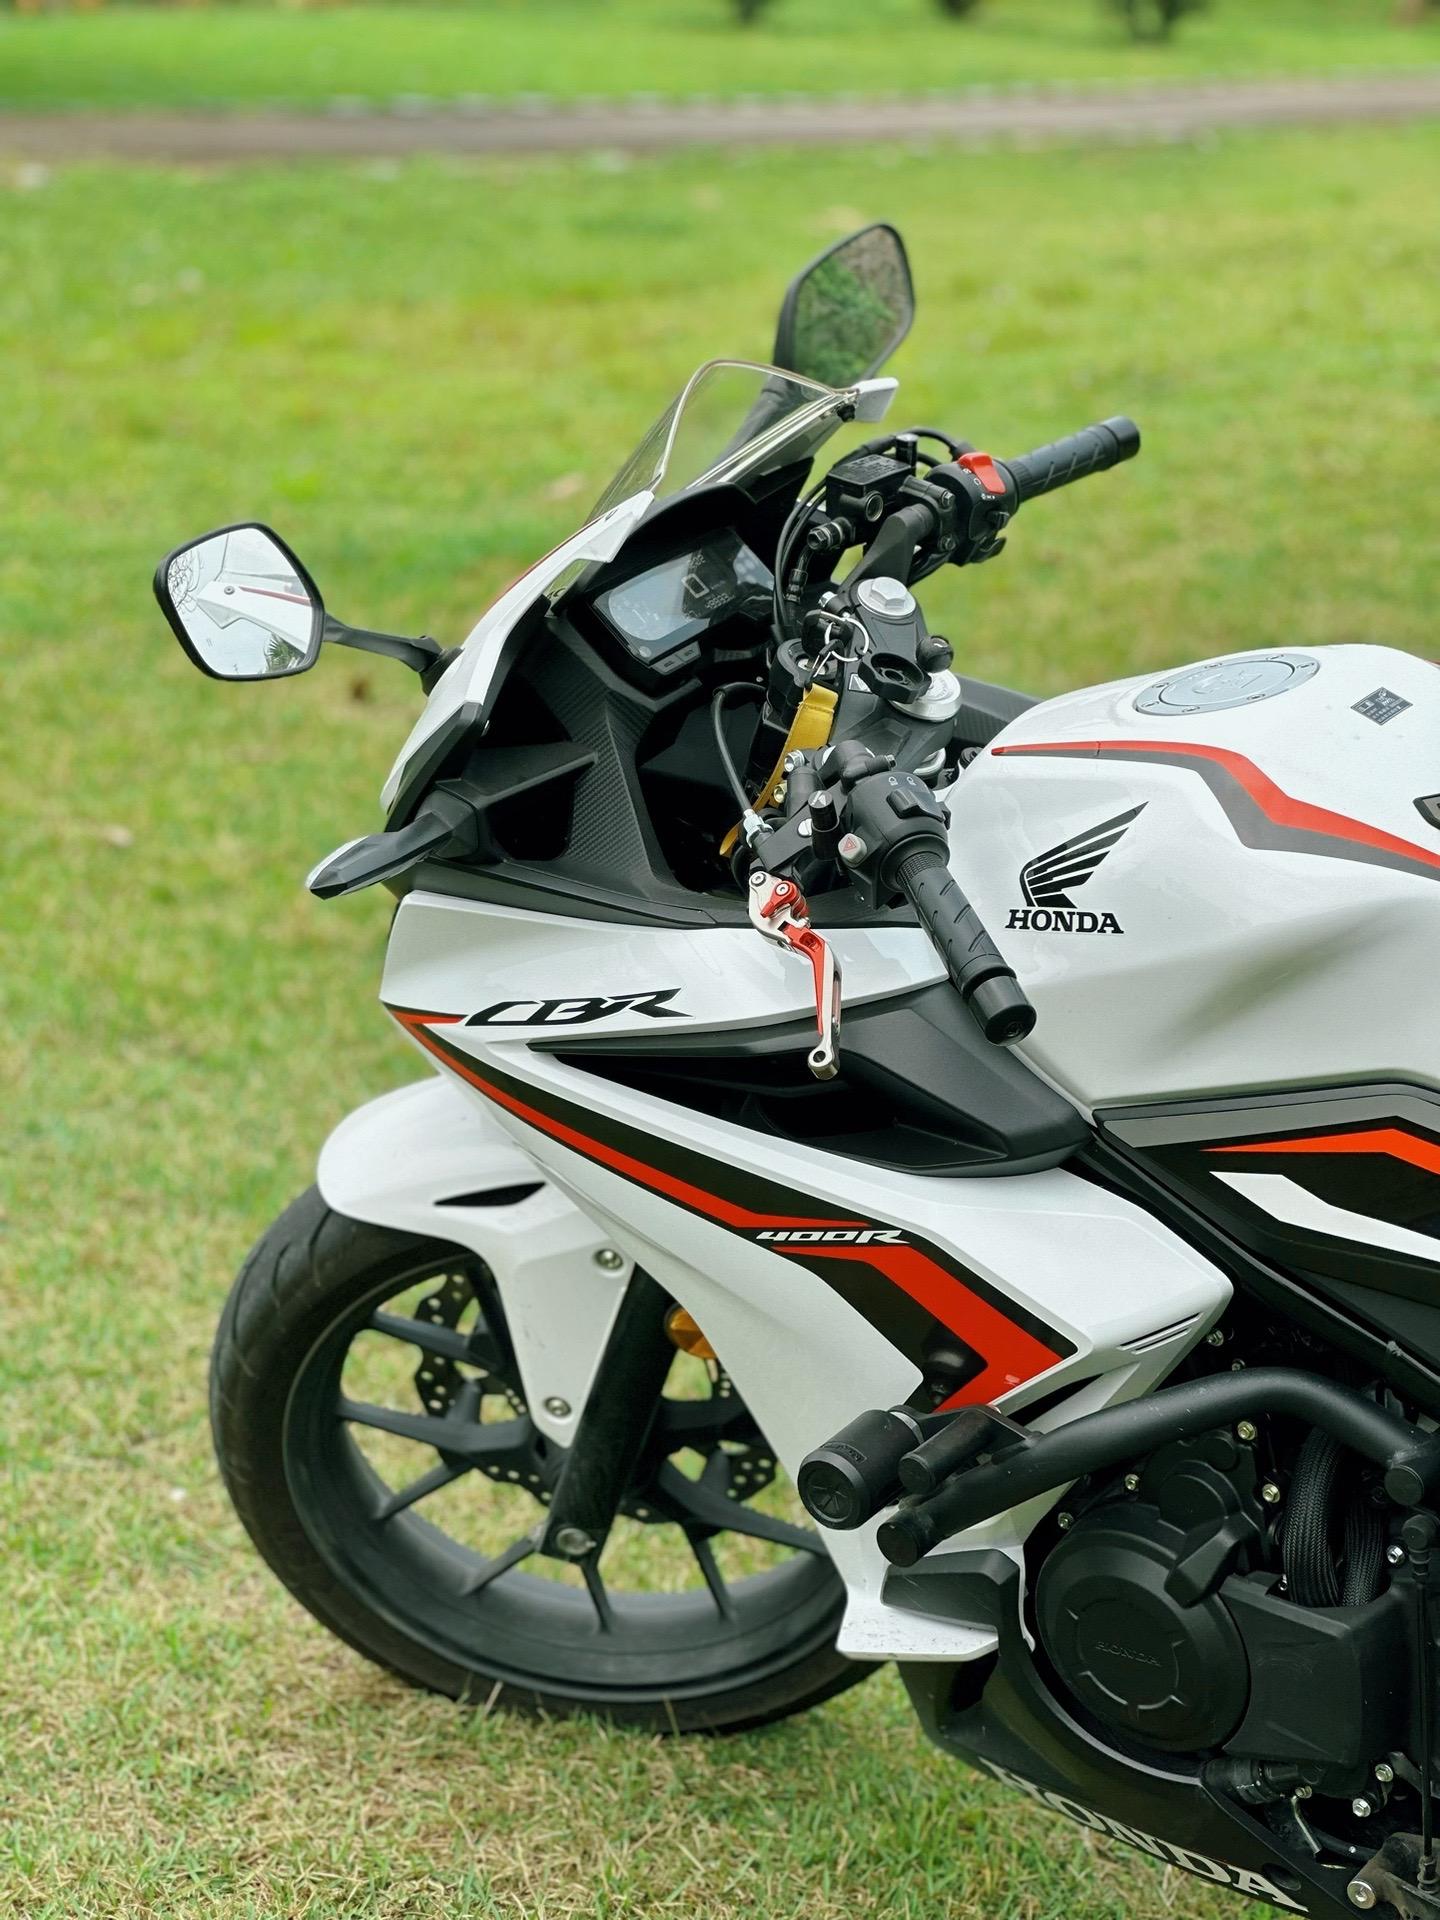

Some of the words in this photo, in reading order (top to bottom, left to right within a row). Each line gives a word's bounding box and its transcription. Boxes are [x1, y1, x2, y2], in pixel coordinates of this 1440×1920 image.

[1005, 909, 1124, 934] HONDA
[465, 988, 694, 1026] CBR
[756, 1230, 910, 1244] 400R
[1095, 1641, 1162, 1667] HONDA
[978, 1756, 1309, 1912] HONDA
